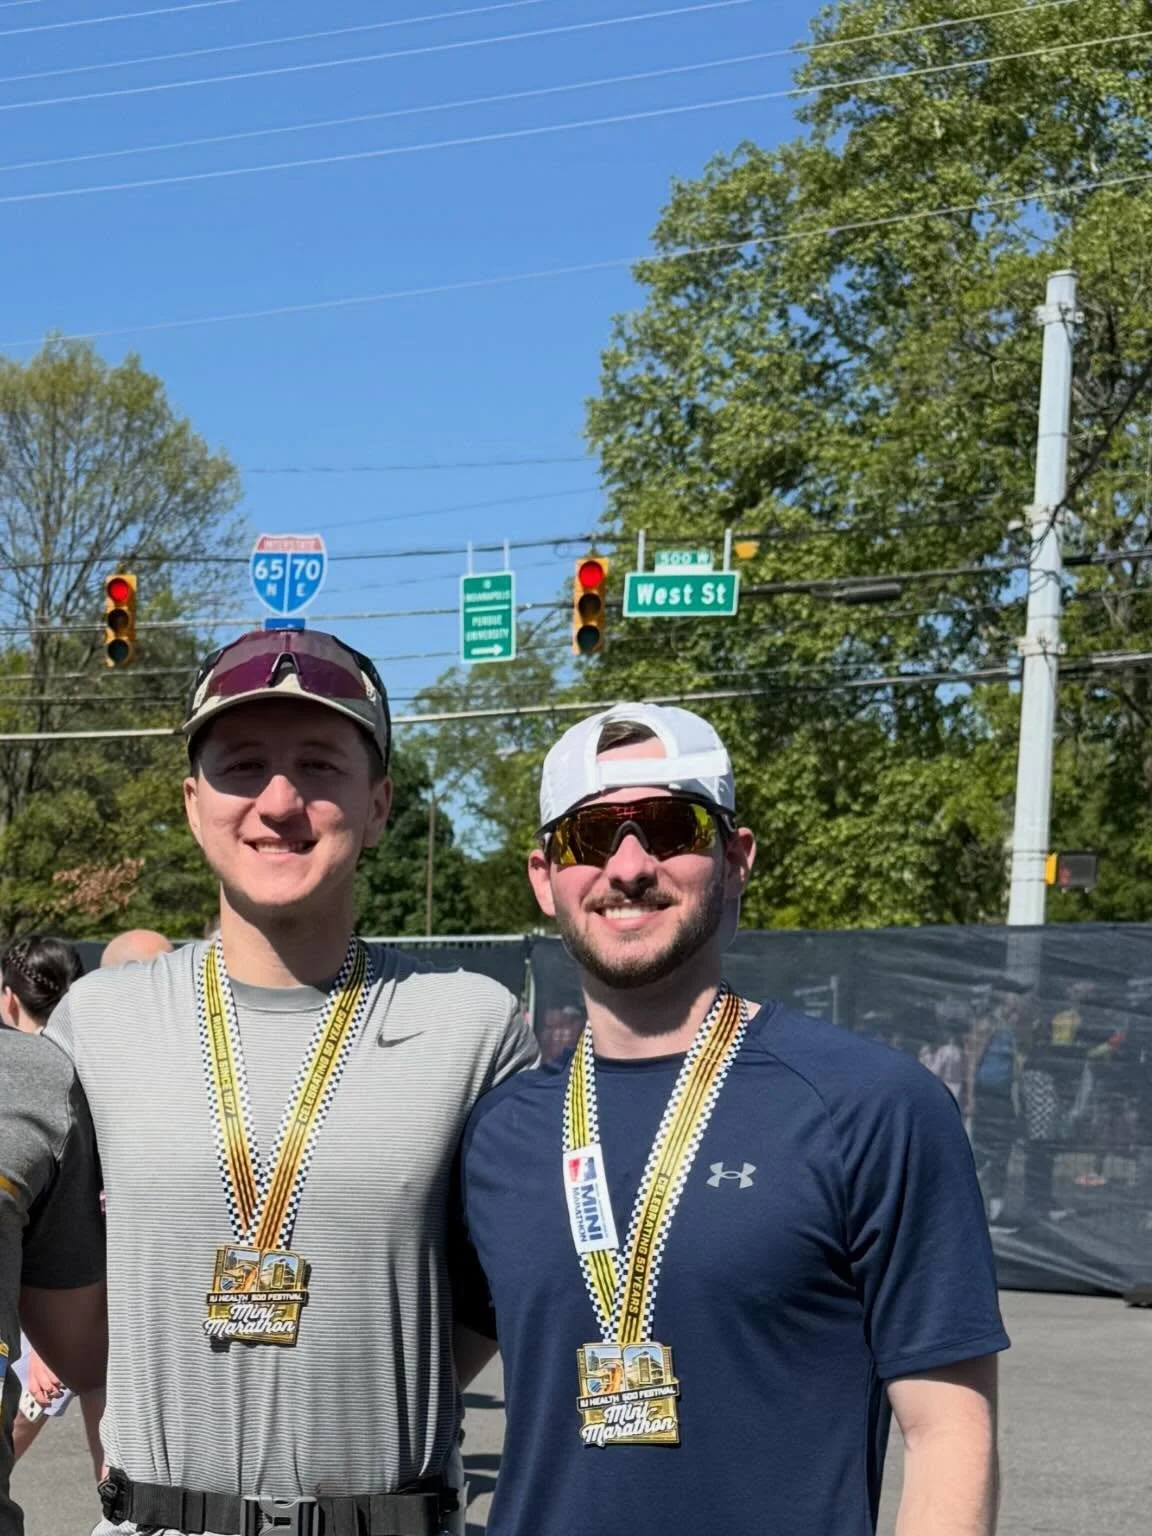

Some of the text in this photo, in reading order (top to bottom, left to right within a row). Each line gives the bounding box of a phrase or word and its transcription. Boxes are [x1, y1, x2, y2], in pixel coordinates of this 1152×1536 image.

[254, 559, 321, 581] 65 70
[636, 582, 726, 605] West St
[298, 1056, 330, 1123] CELEBRATING
[573, 1187, 588, 1242] MARATHON
[581, 1184, 604, 1240] MINI
[629, 1176, 669, 1314] CELEBRATING 50 YEARS
[204, 1318, 296, 1337] Marathon
[589, 1396, 620, 1407] HEALTH
[622, 1392, 638, 1402] 500
[639, 1387, 676, 1399] FESTIVAL
[581, 1418, 675, 1447] Marathon
